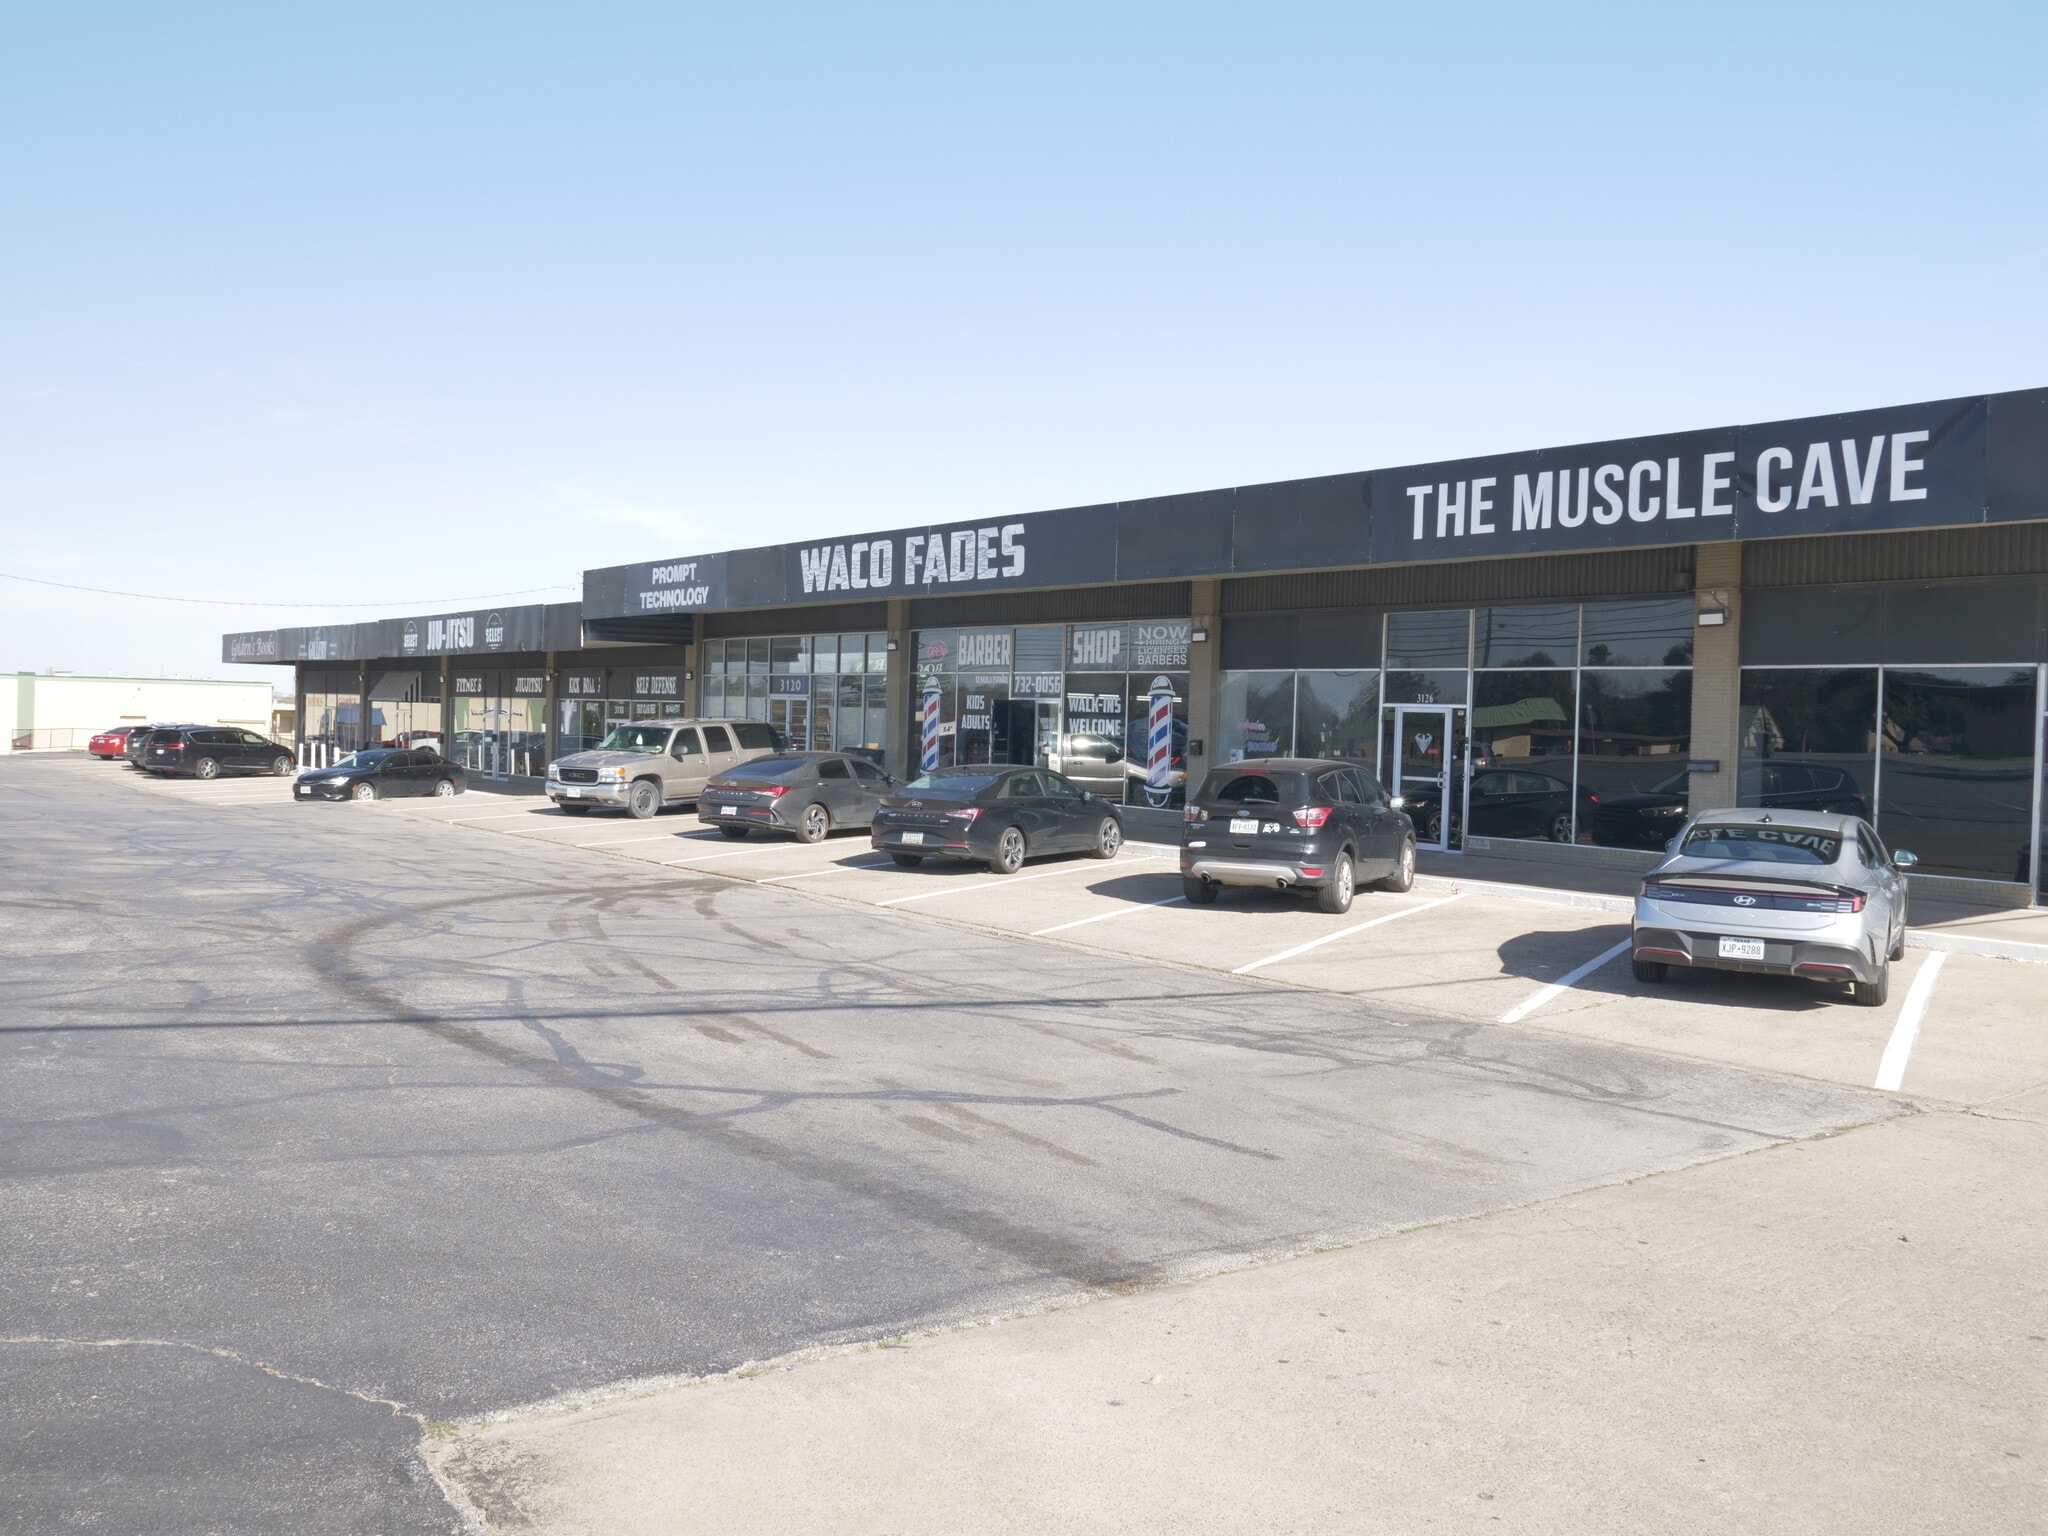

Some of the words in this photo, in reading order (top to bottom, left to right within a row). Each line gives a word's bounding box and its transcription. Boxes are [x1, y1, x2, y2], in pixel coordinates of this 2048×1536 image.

[1406, 477, 1497, 540] THE
[1511, 451, 1736, 532] MUSCLE
[1756, 430, 1930, 513] CAVE
[800, 540, 893, 593] WACO
[904, 523, 1026, 585] FADES
[652, 563, 697, 584] PROMPT
[640, 586, 709, 609] TECHNOLOGY
[427, 617, 474, 650] JIU-JITSU
[485, 627, 503, 643] SELECT
[1139, 626, 1187, 640] NOW
[231, 636, 256, 660] Golden's
[256, 634, 275, 656] Books
[927, 644, 947, 657] OPEN
[959, 634, 1011, 665] BARBER
[1073, 630, 1120, 663] SHOP
[1137, 654, 1187, 665] BARBERS
[515, 677, 543, 693] JIUJITSU
[568, 677, 580, 693] KICK
[636, 676, 649, 694] SELF
[651, 676, 677, 694] DEFENSE
[780, 679, 801, 691] 3120
[1014, 676, 1061, 693] 732-0056
[966, 695, 985, 709] KIDS
[1068, 697, 1121, 713] WALK-INS
[1416, 693, 1434, 703] 3126
[961, 715, 990, 729] ADULTS
[1069, 718, 1121, 735] WELCOME
[1721, 943, 1761, 956] XJP-9288
